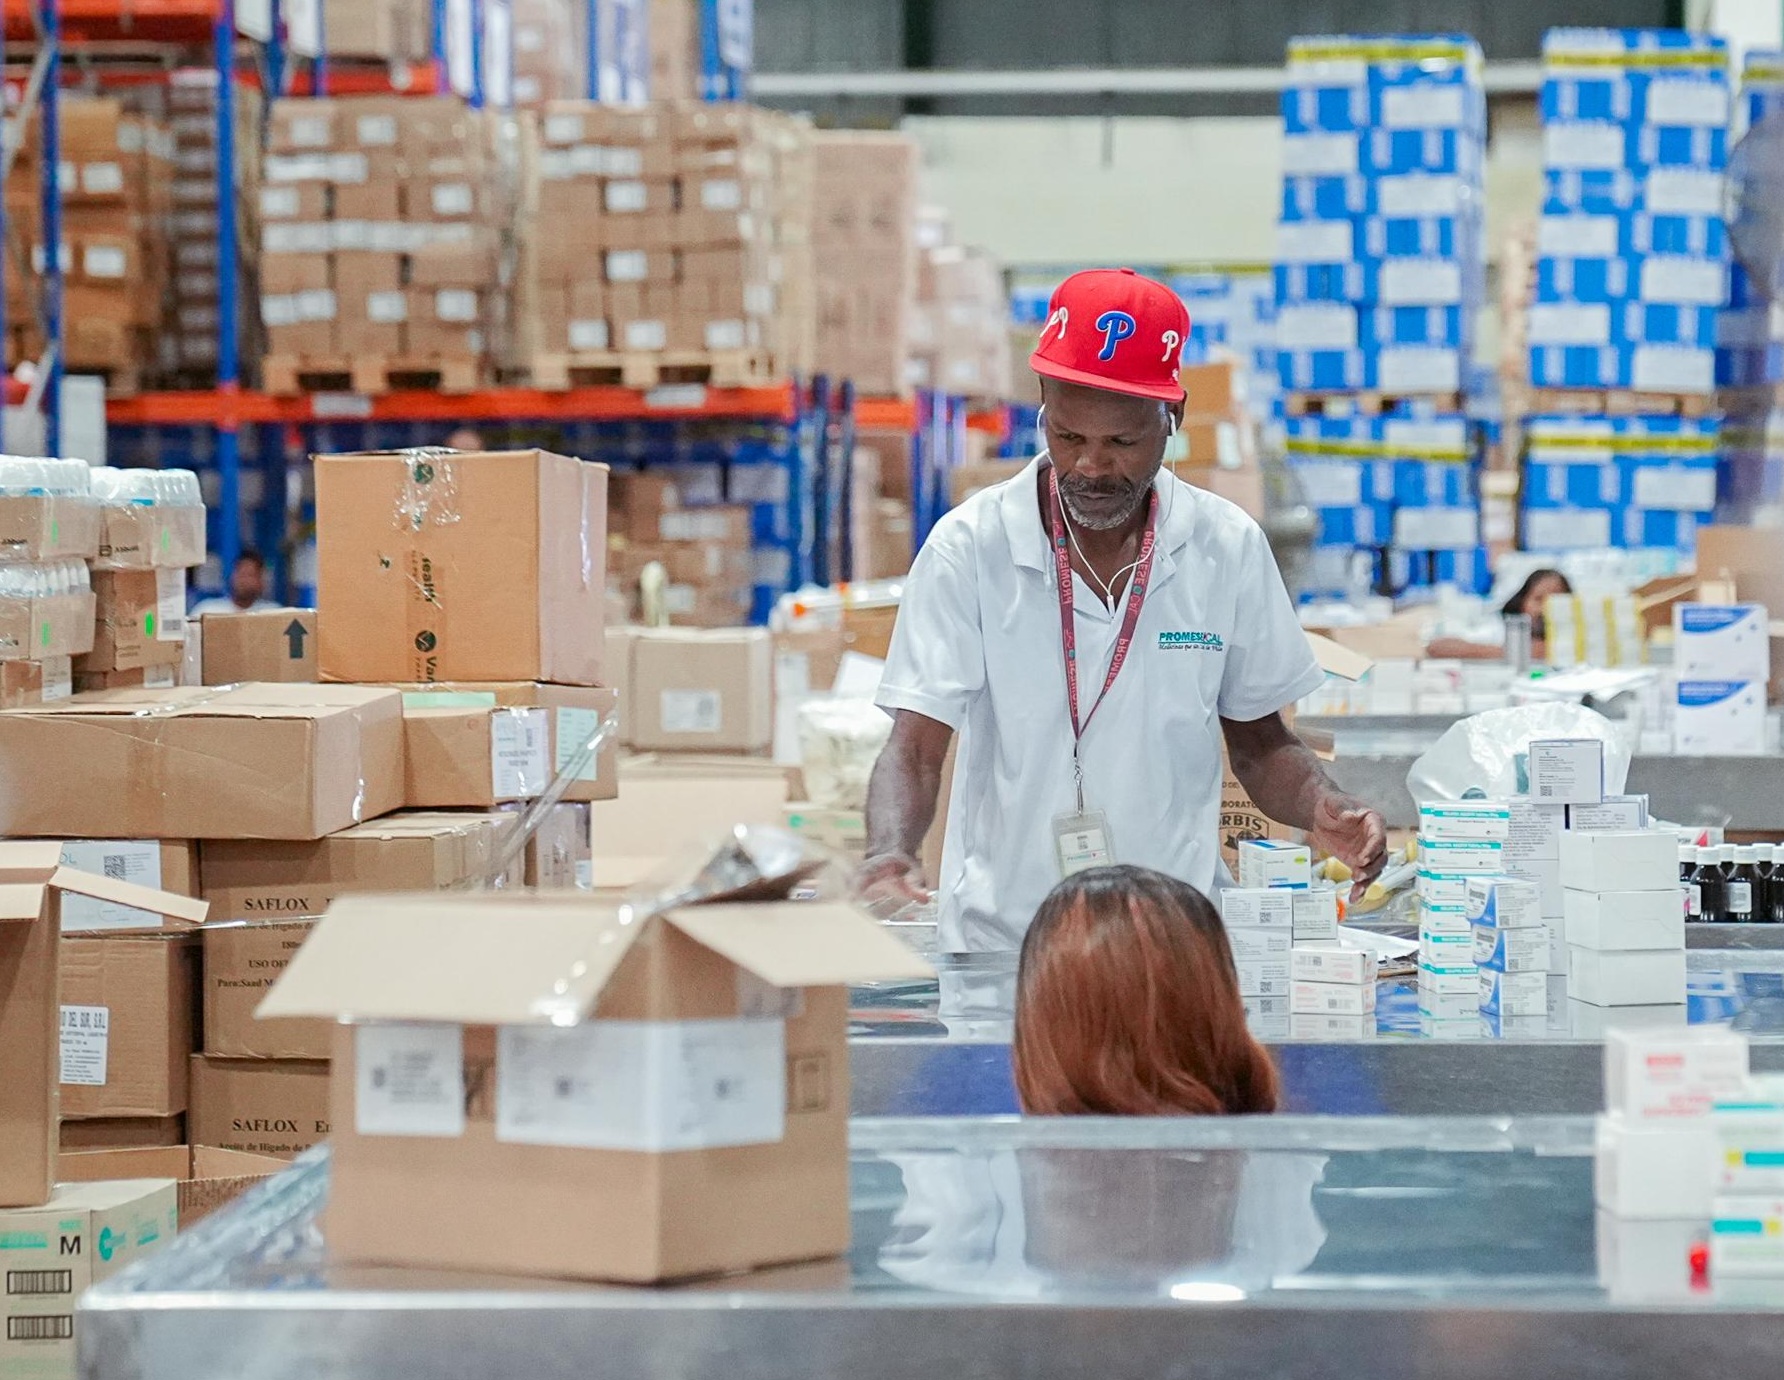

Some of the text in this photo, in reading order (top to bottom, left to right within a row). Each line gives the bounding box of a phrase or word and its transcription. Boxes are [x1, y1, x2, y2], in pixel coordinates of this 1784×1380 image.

[1095, 310, 1136, 361] P
[1161, 330, 1180, 362] P
[1219, 814, 1263, 832] RBIS
[244, 897, 310, 912] SAFLOX
[232, 1118, 298, 1133] SAFLOX
[60, 1235, 81, 1255] M
